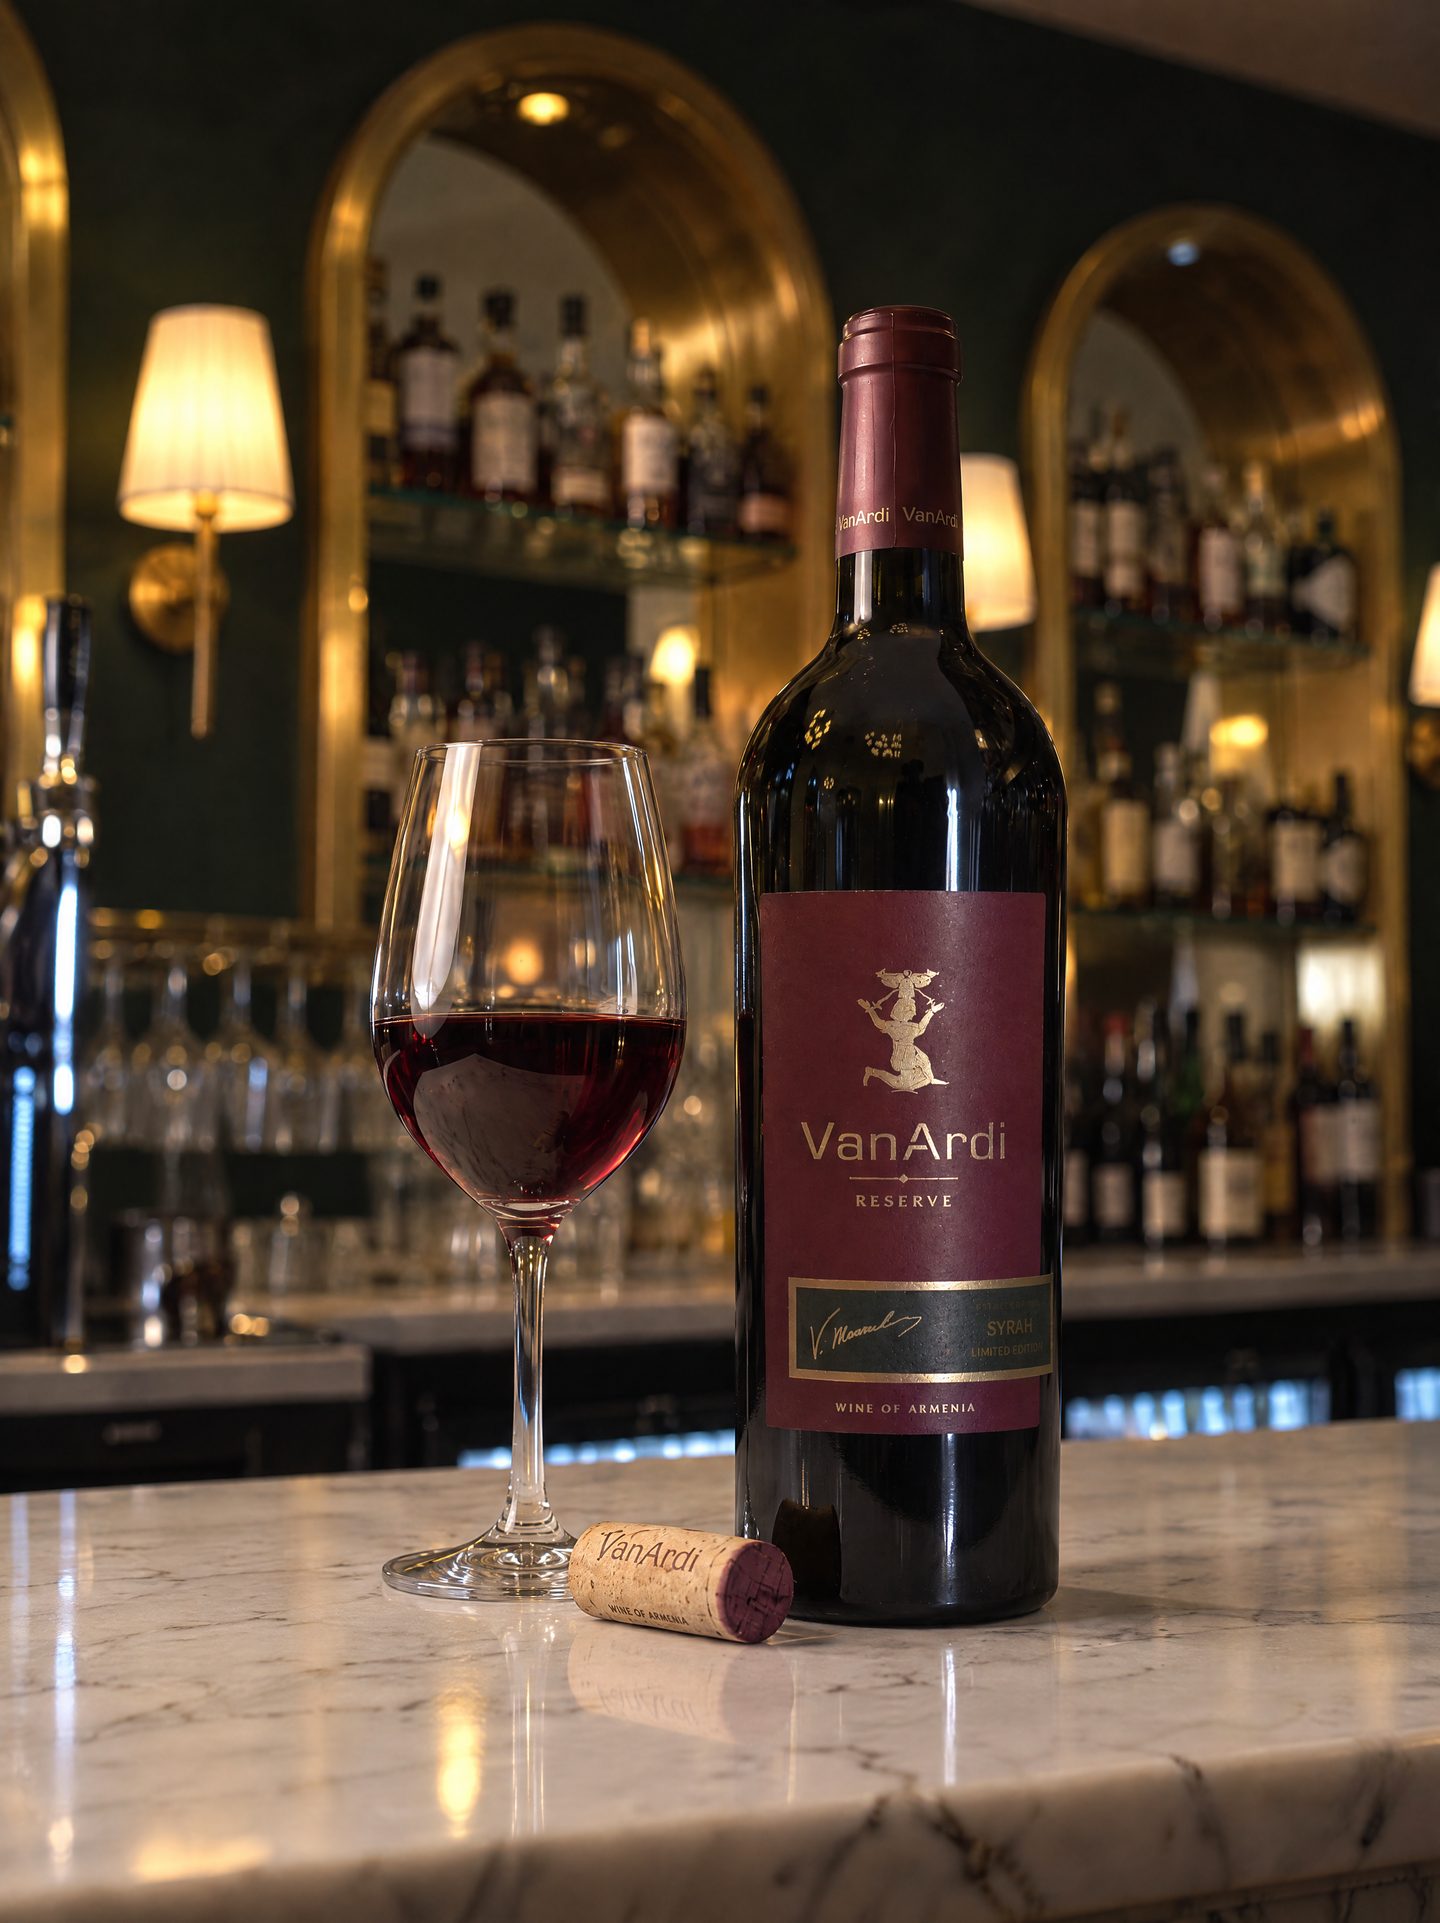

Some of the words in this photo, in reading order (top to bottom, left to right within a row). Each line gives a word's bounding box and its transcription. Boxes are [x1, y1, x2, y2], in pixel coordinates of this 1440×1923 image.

[838, 507, 890, 531] VanArdi
[902, 507, 959, 529] VanArdi
[801, 1121, 1006, 1161] VanArdi
[856, 1194, 952, 1208] RESERVE
[987, 1317, 1033, 1337] SYRAH
[971, 1345, 1010, 1358] LIMITED
[835, 1402, 874, 1414] WINE
[881, 1403, 900, 1414] OF
[908, 1402, 976, 1414] ARMENIA
[598, 1530, 702, 1573] VanArdi
[608, 1604, 633, 1617] WINE
[633, 1608, 646, 1618] OF
[648, 1611, 689, 1626] ARMENIA
